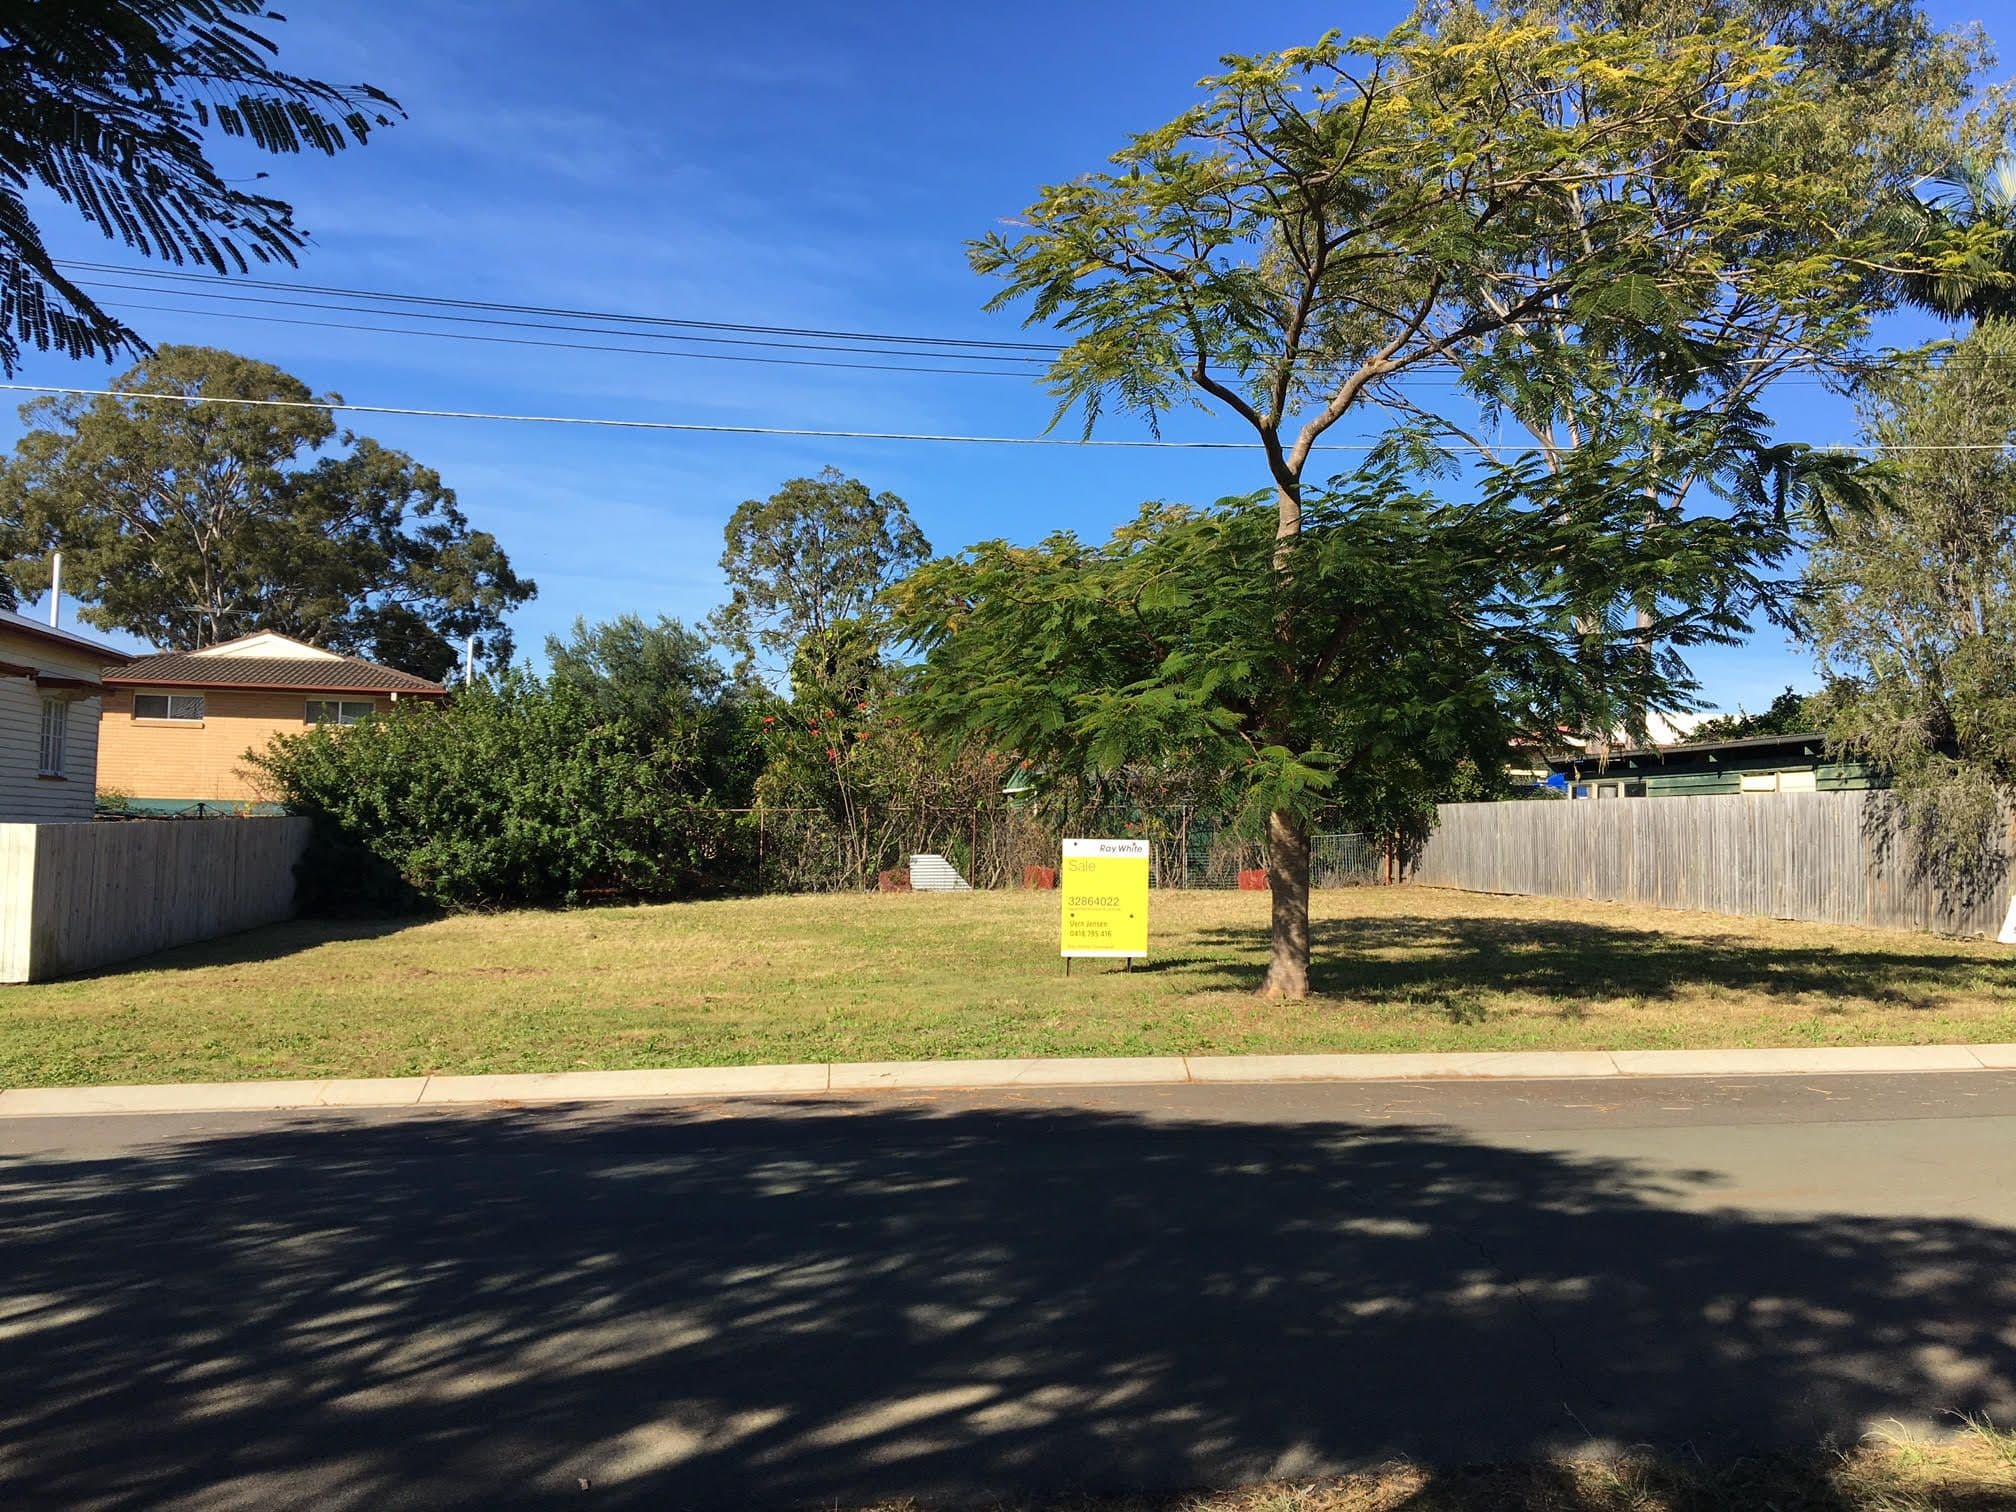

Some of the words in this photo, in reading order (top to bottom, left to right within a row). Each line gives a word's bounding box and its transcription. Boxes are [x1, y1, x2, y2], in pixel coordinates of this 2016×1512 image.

[1100, 844, 1116, 853] Ray
[1118, 844, 1143, 853] White
[1068, 859, 1096, 872] Sale
[1068, 896, 1120, 907] 32864022
